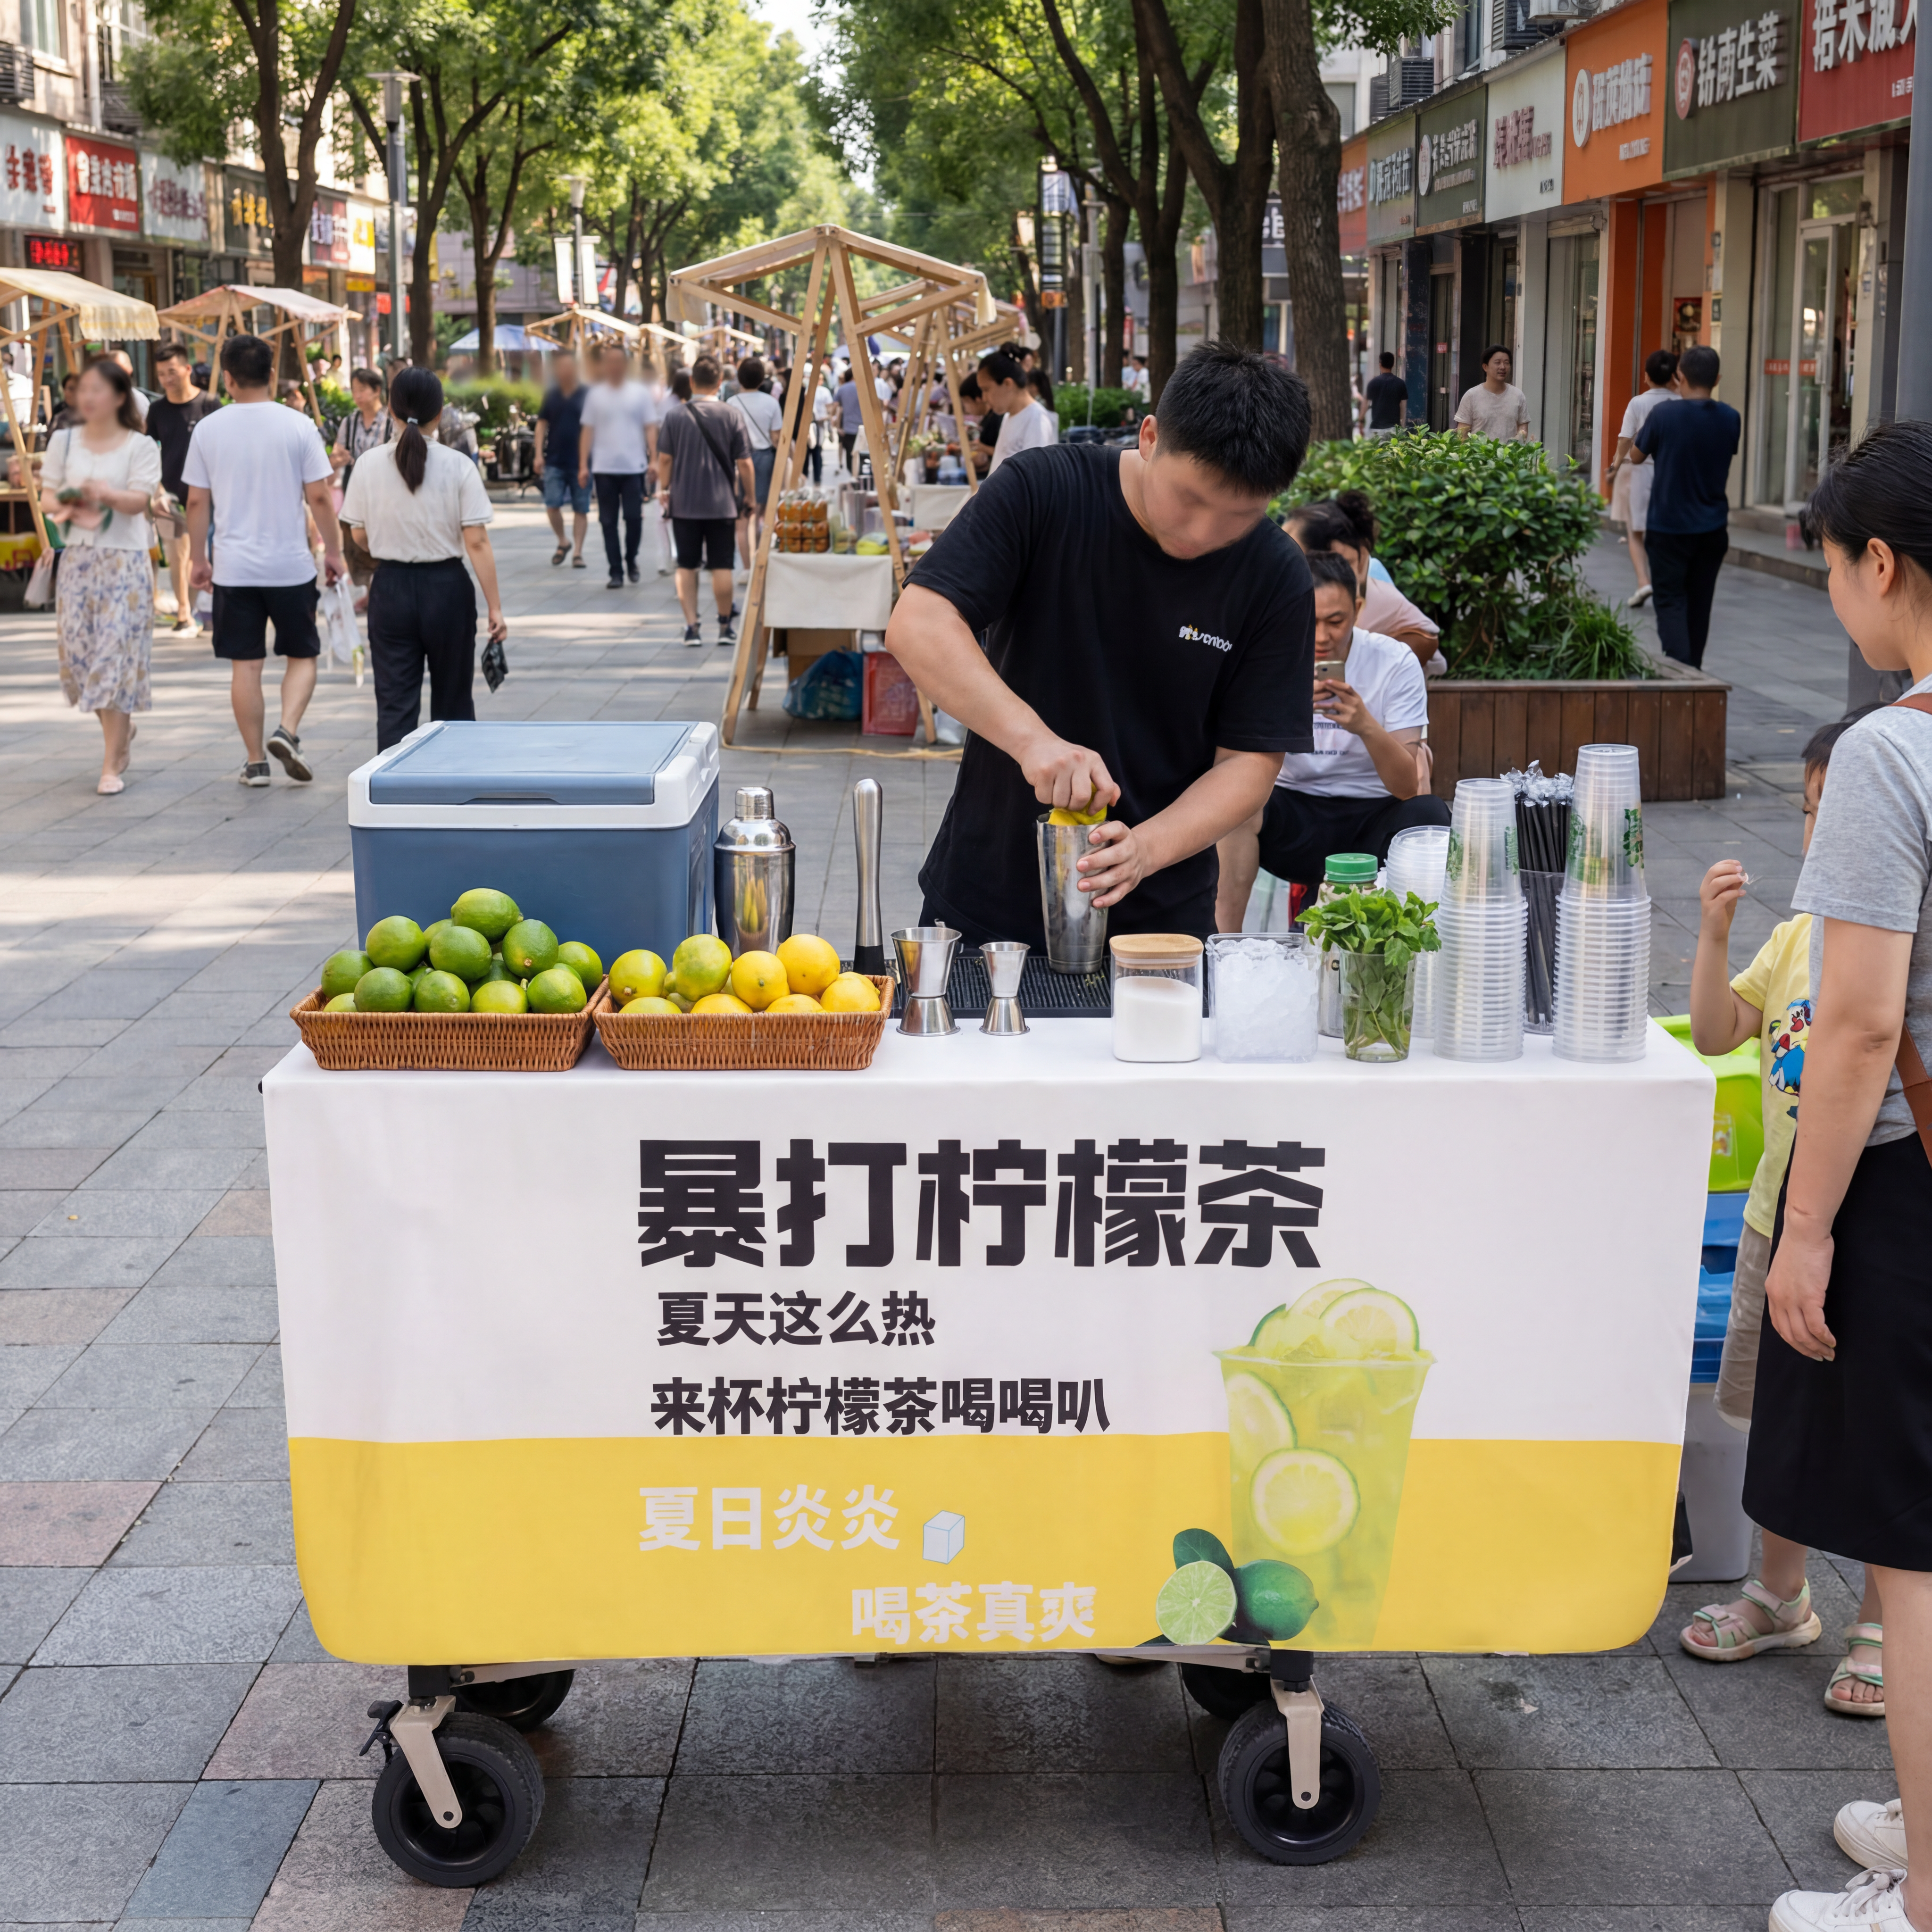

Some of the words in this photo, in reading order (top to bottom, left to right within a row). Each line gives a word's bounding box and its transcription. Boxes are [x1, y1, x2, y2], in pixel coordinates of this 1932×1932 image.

[638, 1139, 1325, 1268] 暴打柠檬茶
[657, 1290, 936, 1346] 夏天这么热
[650, 1377, 1110, 1435] 来杯柠檬茶喝喝叭
[639, 1484, 900, 1551] 夏日炎炎
[852, 1581, 1097, 1645] 喝茶真爽
